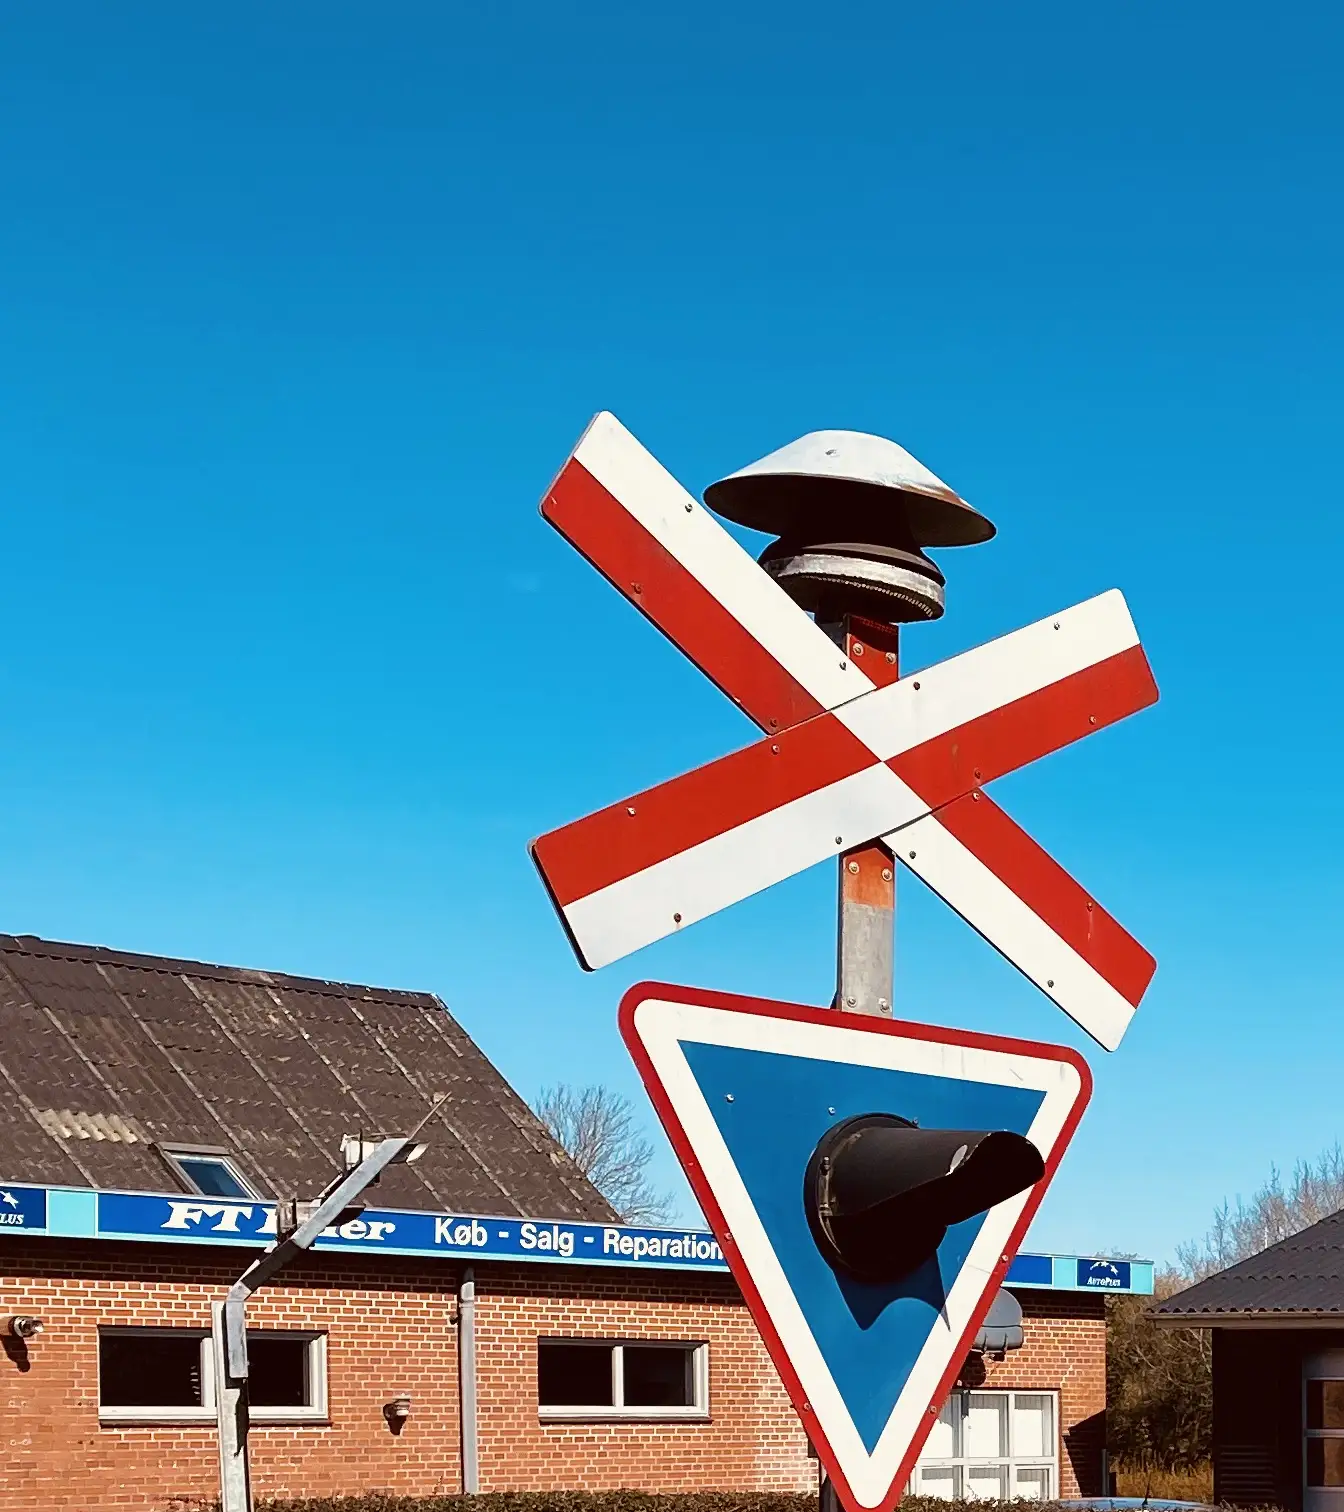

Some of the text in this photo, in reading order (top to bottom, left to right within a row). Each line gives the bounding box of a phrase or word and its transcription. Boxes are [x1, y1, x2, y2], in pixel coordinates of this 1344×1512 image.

[160, 1202, 253, 1233] FT
[434, 1217, 488, 1247] Køb
[519, 1222, 575, 1257] Salg
[603, 1228, 724, 1260] Reparation
